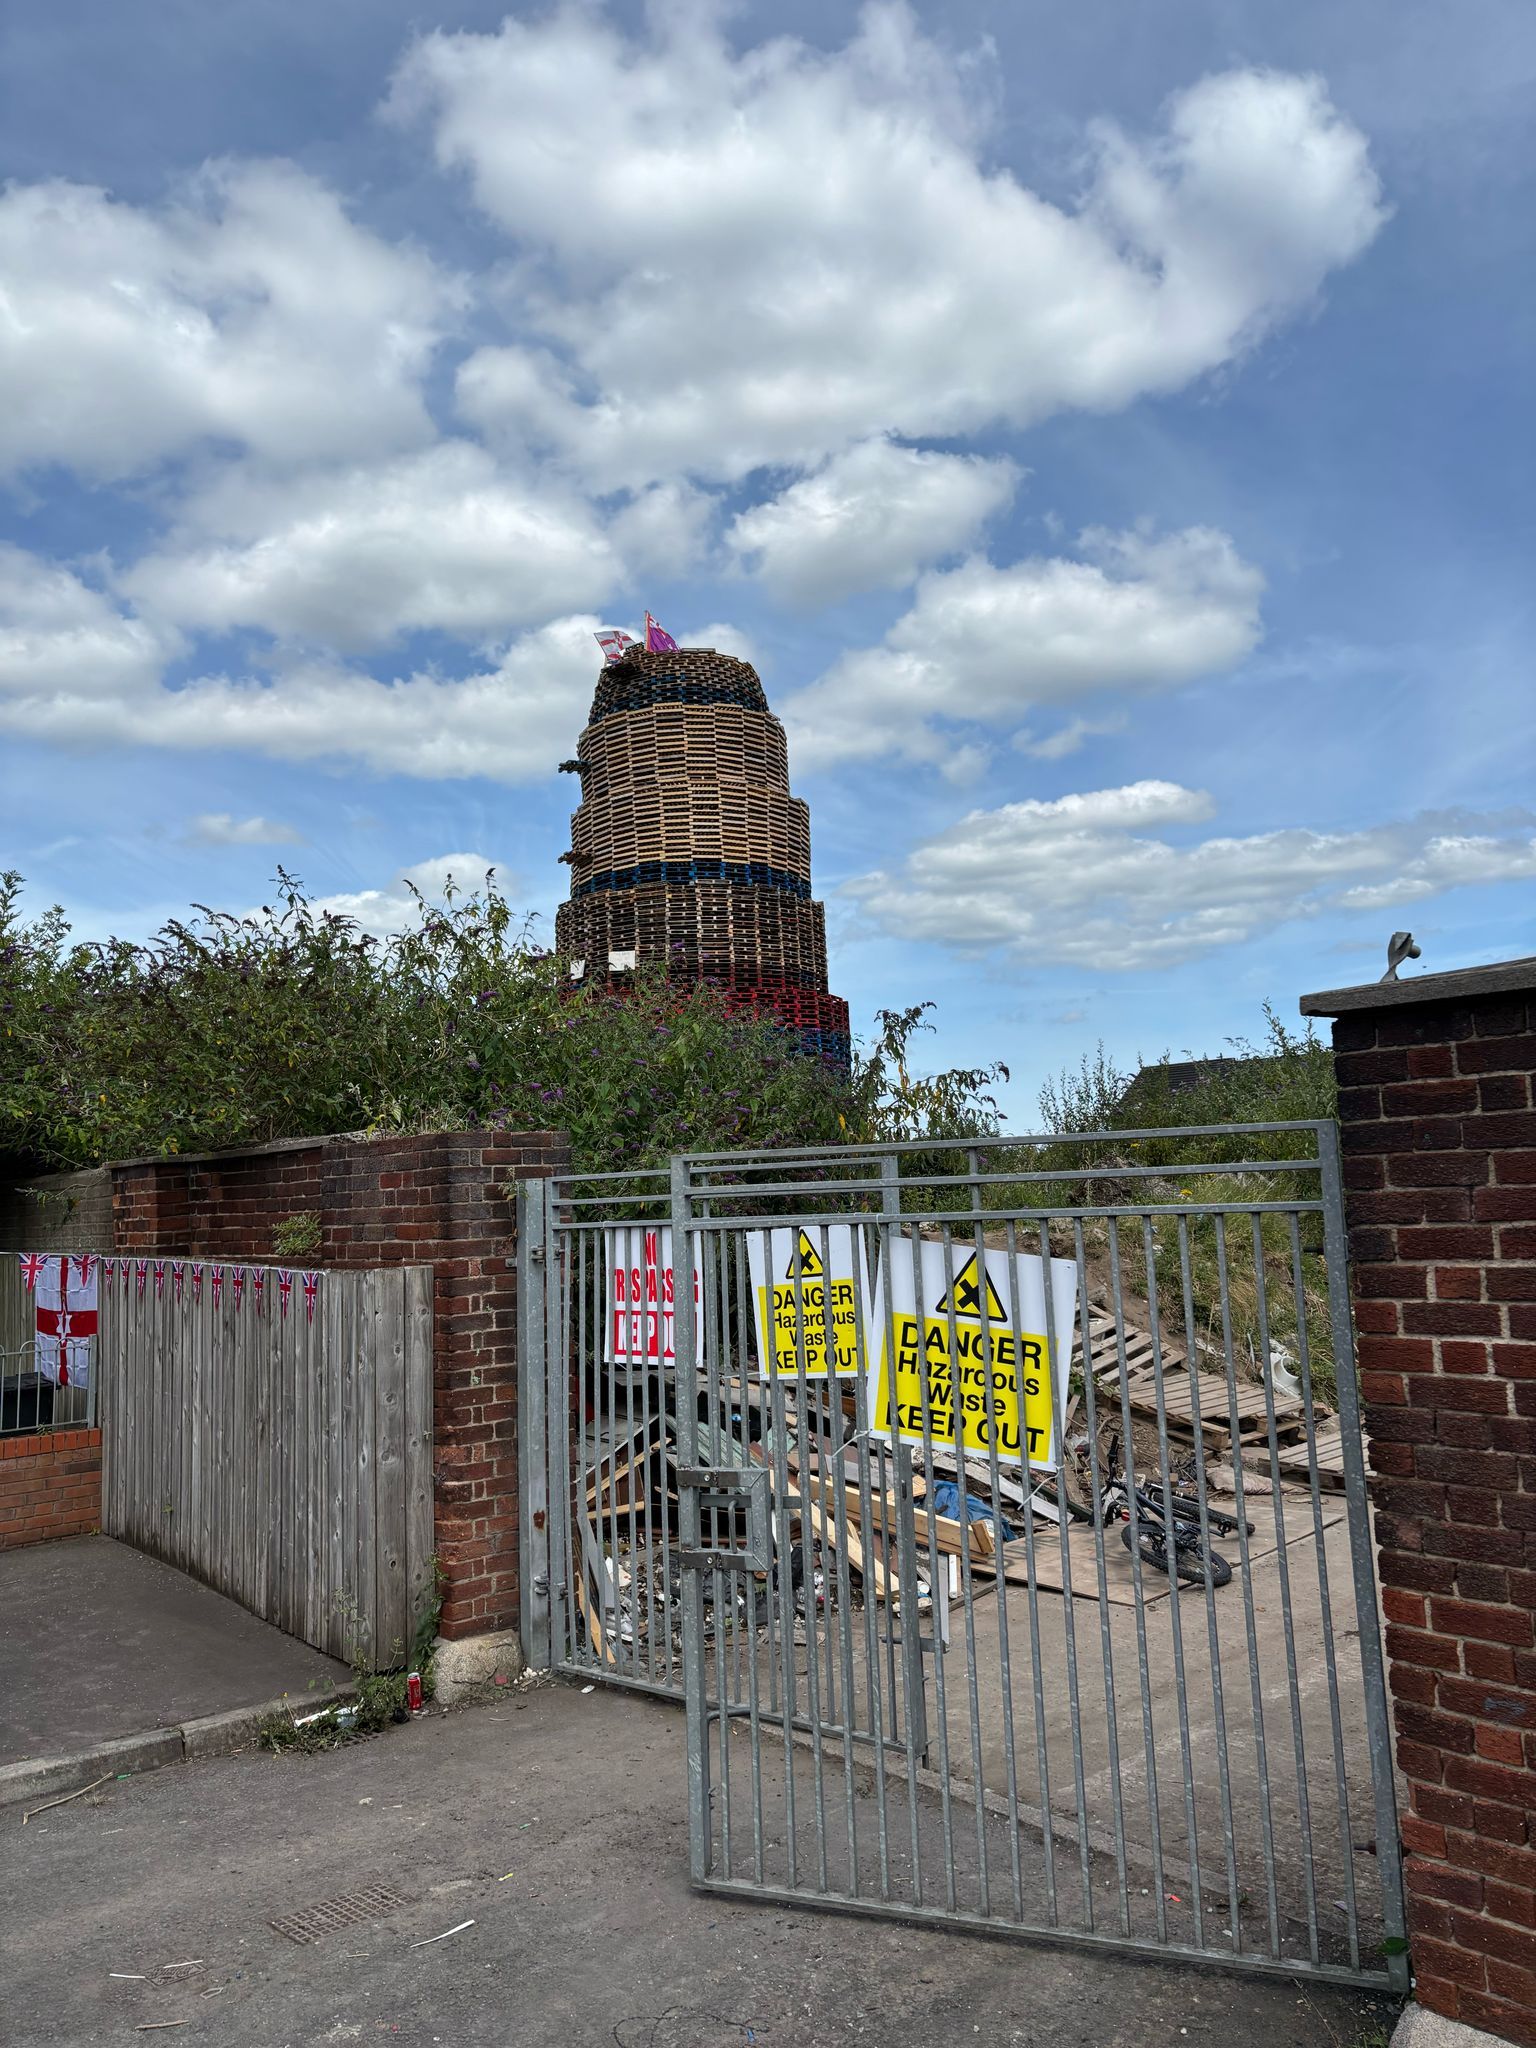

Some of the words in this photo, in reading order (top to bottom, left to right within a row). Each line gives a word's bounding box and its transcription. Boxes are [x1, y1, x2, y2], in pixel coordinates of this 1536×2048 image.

[901, 1321, 1042, 1370] DANGER
[885, 1401, 967, 1437] KEEP
[976, 1418, 1045, 1453] OUT
